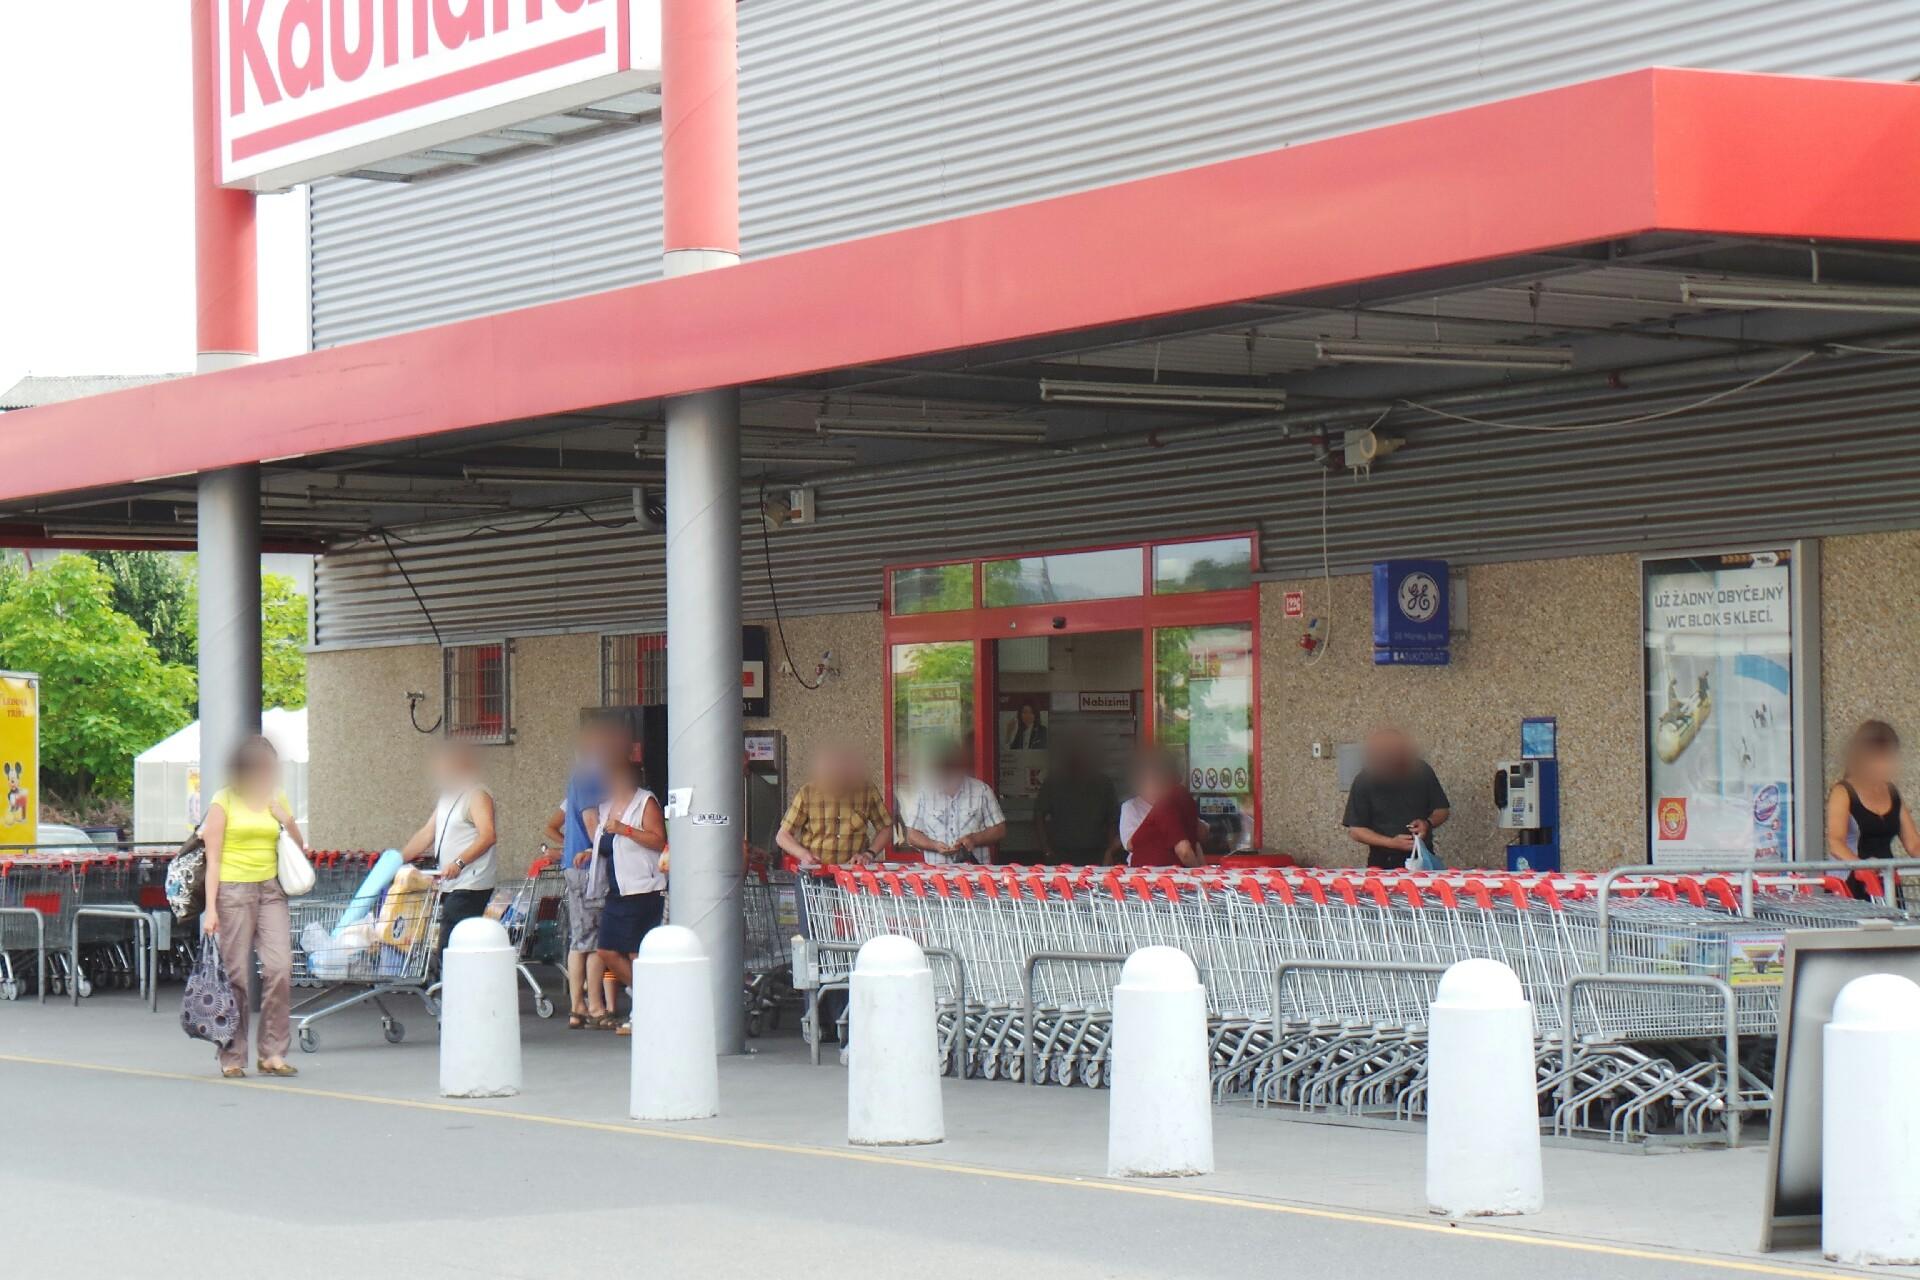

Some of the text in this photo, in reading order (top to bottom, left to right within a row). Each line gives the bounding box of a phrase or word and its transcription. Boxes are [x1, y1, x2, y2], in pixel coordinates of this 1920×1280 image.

[1654, 590, 1671, 608] UŽ
[1717, 583, 1784, 604] OBYČEJNÝ
[1666, 614, 1686, 628] WC
[1688, 612, 1721, 627] BLOK
[1723, 611, 1731, 625] S
